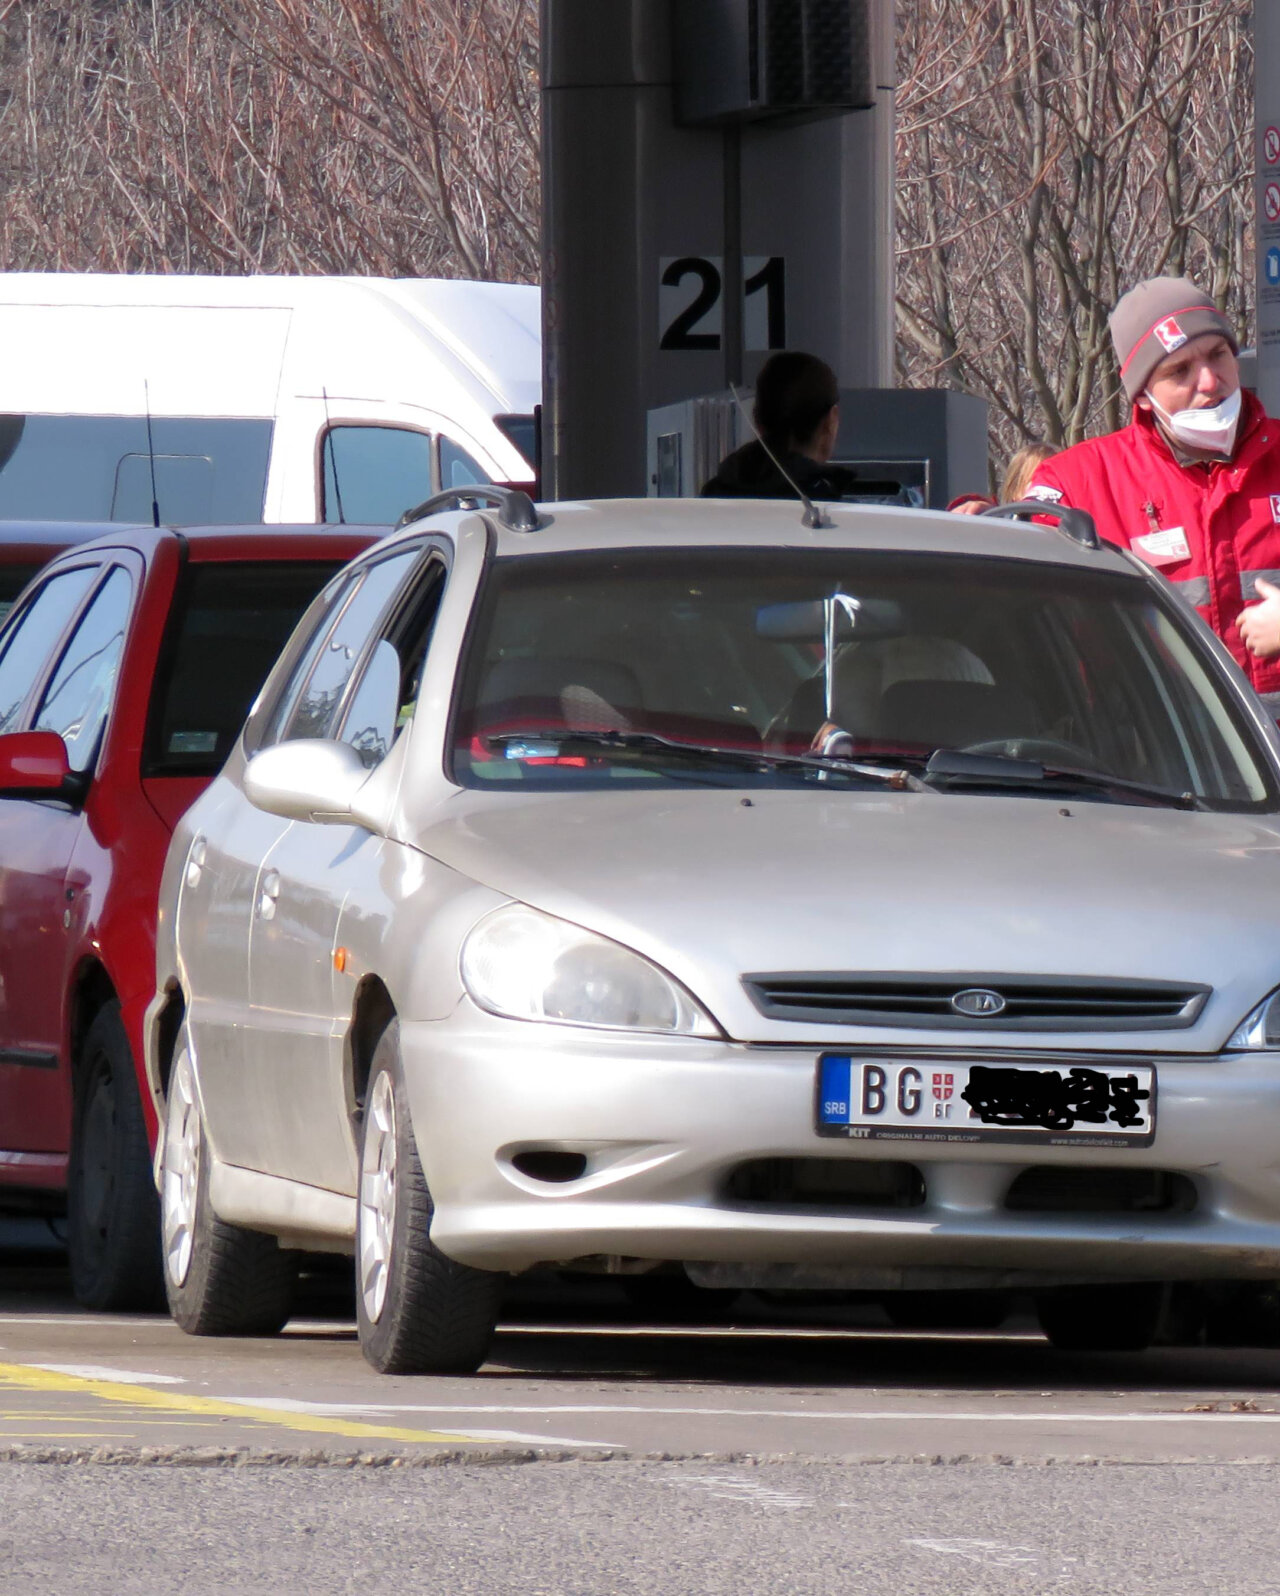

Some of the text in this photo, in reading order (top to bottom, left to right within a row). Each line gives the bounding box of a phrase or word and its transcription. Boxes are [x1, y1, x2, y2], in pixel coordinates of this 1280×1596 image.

[860, 1063, 923, 1117] BG
[824, 1101, 847, 1116] SRB
[848, 1127, 871, 1138] KIT
